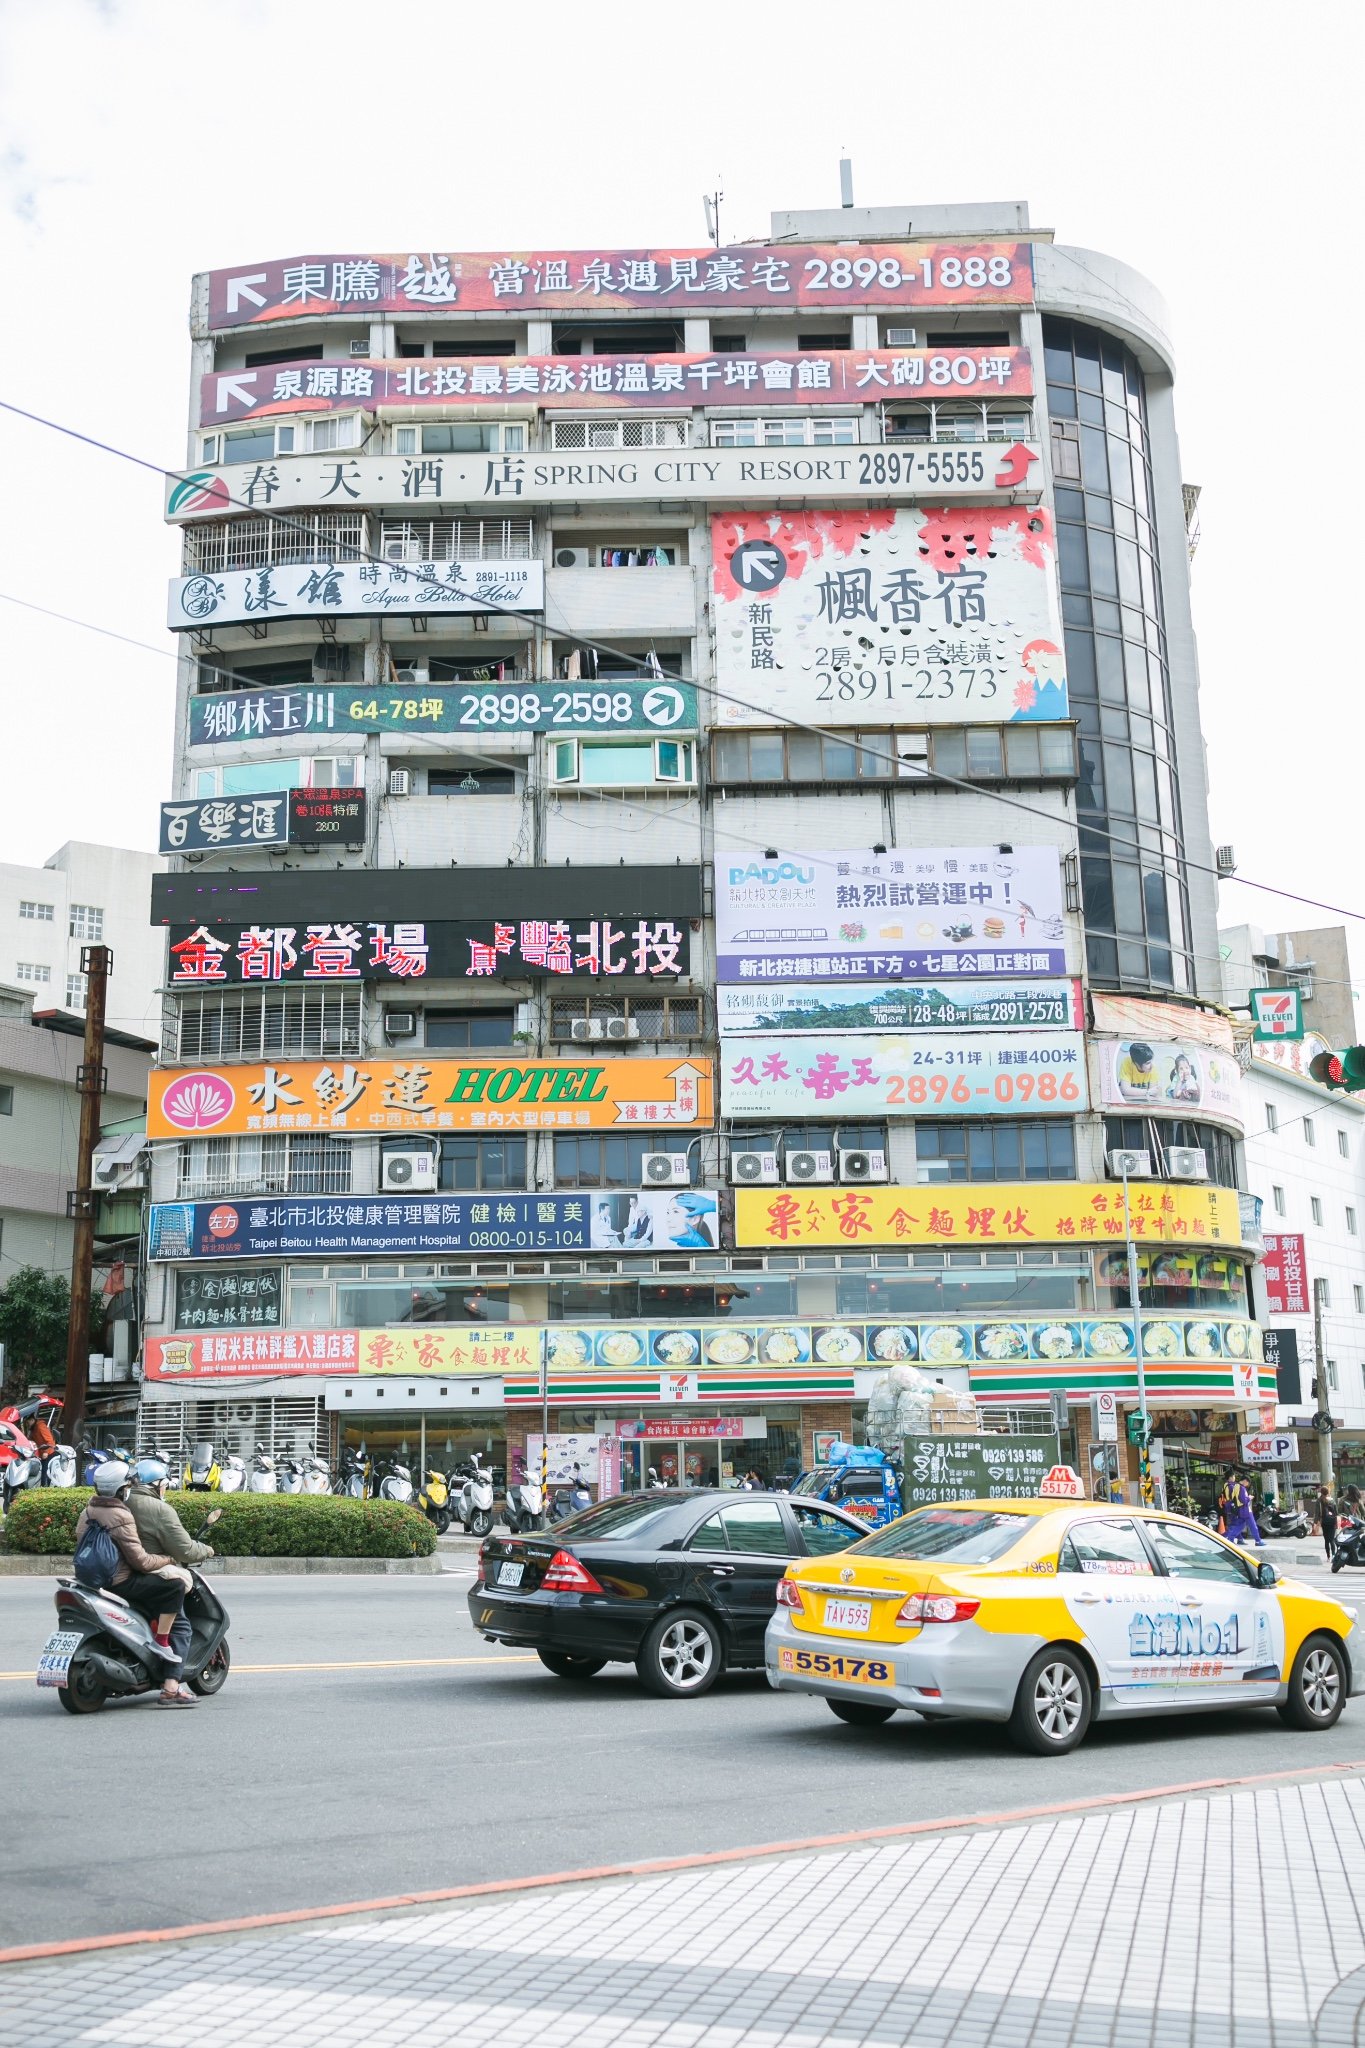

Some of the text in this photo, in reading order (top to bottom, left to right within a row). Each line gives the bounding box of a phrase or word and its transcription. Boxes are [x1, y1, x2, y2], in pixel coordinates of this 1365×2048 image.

[281, 260, 381, 304] 東騰
[397, 253, 457, 303] 越
[488, 256, 790, 296] 當溫泉遇見豪宅
[804, 256, 1012, 290] 2898-1888
[272, 356, 1011, 400] 泉源路 北投最美泳池溫泉千坪會館 大砌80坪
[533, 462, 638, 486] SPRING
[654, 461, 720, 482] CITY
[740, 460, 852, 482] RESORT
[858, 451, 984, 485] 2897-5555
[359, 562, 528, 585] 時尚溫泉 2891-1118
[362, 584, 523, 608] Aqua Bella Hotel
[814, 564, 989, 624] 楓香宿
[748, 602, 775, 669] 新民路
[815, 668, 998, 700] 2891-2373
[203, 692, 632, 740] 鄉林玉川 64-78坪 2898-2598
[315, 821, 340, 832] 2800
[729, 863, 815, 886] BADOU
[729, 888, 816, 901] 新北投文創天地
[170, 922, 429, 979] 金都登場
[873, 1014, 903, 1024] 700公尺
[914, 1005, 967, 1023] 28-48坪
[990, 1002, 1064, 1021] 2891-2578
[914, 1050, 1077, 1065] 24-31坪 捷運400米
[445, 1067, 609, 1103] HOTEL
[680, 1077, 694, 1112] 本棟
[886, 1073, 1079, 1104] 2896-0986
[246, 1110, 590, 1129] 寬頻無線上網 中西式早餐 室內大型停車場
[1091, 1193, 1175, 1212] 台式拉麵
[209, 1213, 237, 1229] 左方
[249, 1203, 460, 1227] 臺北市北投健康管理醫院
[886, 1206, 1036, 1238] 食麵埋伏
[1208, 1192, 1220, 1238] 請上二樓
[249, 1231, 583, 1249] Taipei Beitou Health Management Hospital 0800-015-104
[157, 1247, 190, 1256] 中和街2號
[1282, 1237, 1304, 1311] 新北投甘蔗
[204, 1277, 275, 1297] 食麵埋伏
[469, 1331, 515, 1342] 請上二樓
[201, 1334, 355, 1362] 臺版米其林評鑑入選店家
[450, 1346, 533, 1366] 食麵埋伏
[983, 1449, 1044, 1463] 0926 139 586
[1276, 1440, 1289, 1456] P
[913, 1488, 977, 1501] 0926 139 586
[989, 1486, 1012, 1498] 0926
[1015, 1486, 1032, 1498] 139
[1042, 1482, 1077, 1494] 55178
[1025, 1561, 1054, 1573] 7968
[796, 1652, 888, 1681] 55178
